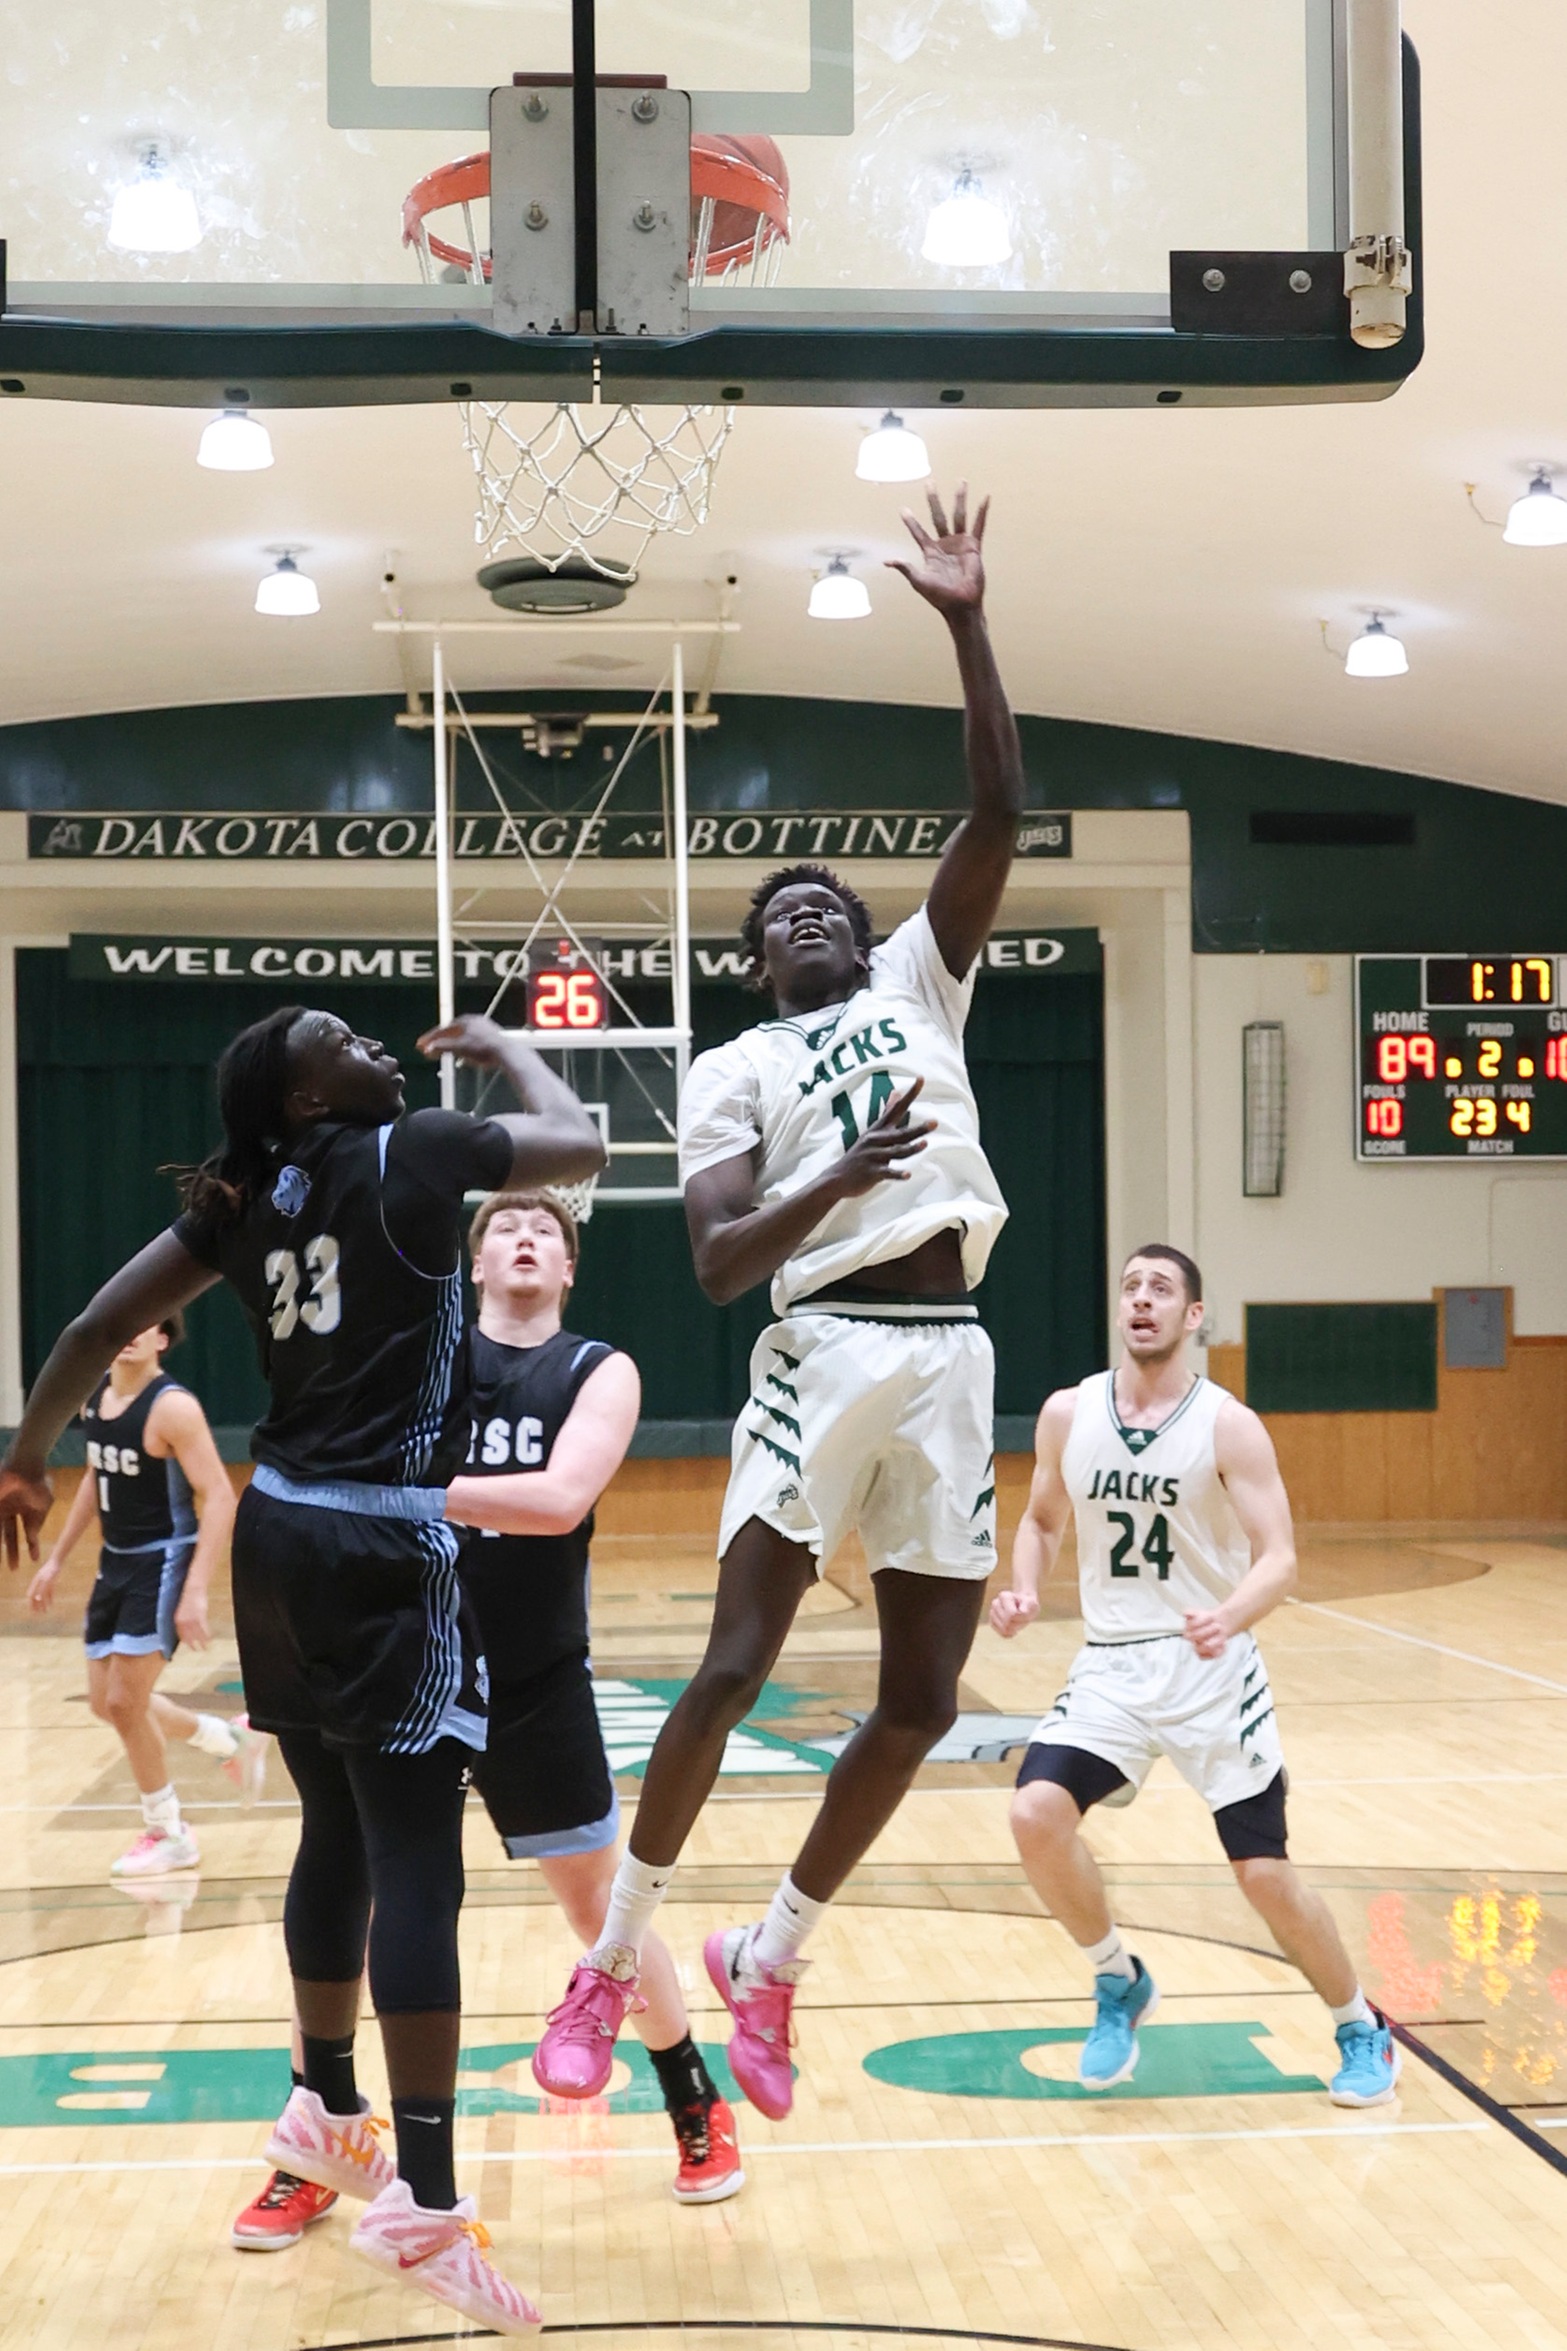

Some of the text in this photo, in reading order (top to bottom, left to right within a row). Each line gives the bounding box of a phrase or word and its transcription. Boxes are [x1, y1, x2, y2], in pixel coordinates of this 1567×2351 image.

[93, 817, 966, 857] DAKOTA COLLEGE AT BOTTINE
[103, 945, 434, 978] WELCOME
[453, 949, 529, 980] TO
[1472, 960, 1550, 1001] 1:17
[534, 974, 600, 1027] 26
[1373, 1011, 1430, 1032] HOME
[1466, 1021, 1514, 1037] PERIOD
[1378, 1035, 1437, 1084] 89
[1478, 1039, 1502, 1078] 2
[1363, 1084, 1406, 1098] FOULS
[1445, 1084, 1535, 1098] PLAYER FOUL
[1366, 1099, 1403, 1137] 10
[1467, 1140, 1514, 1154] MATCH
[264, 1233, 342, 1341] 33
[1087, 1470, 1180, 1507] JACKS
[1106, 1510, 1175, 1581] 24
